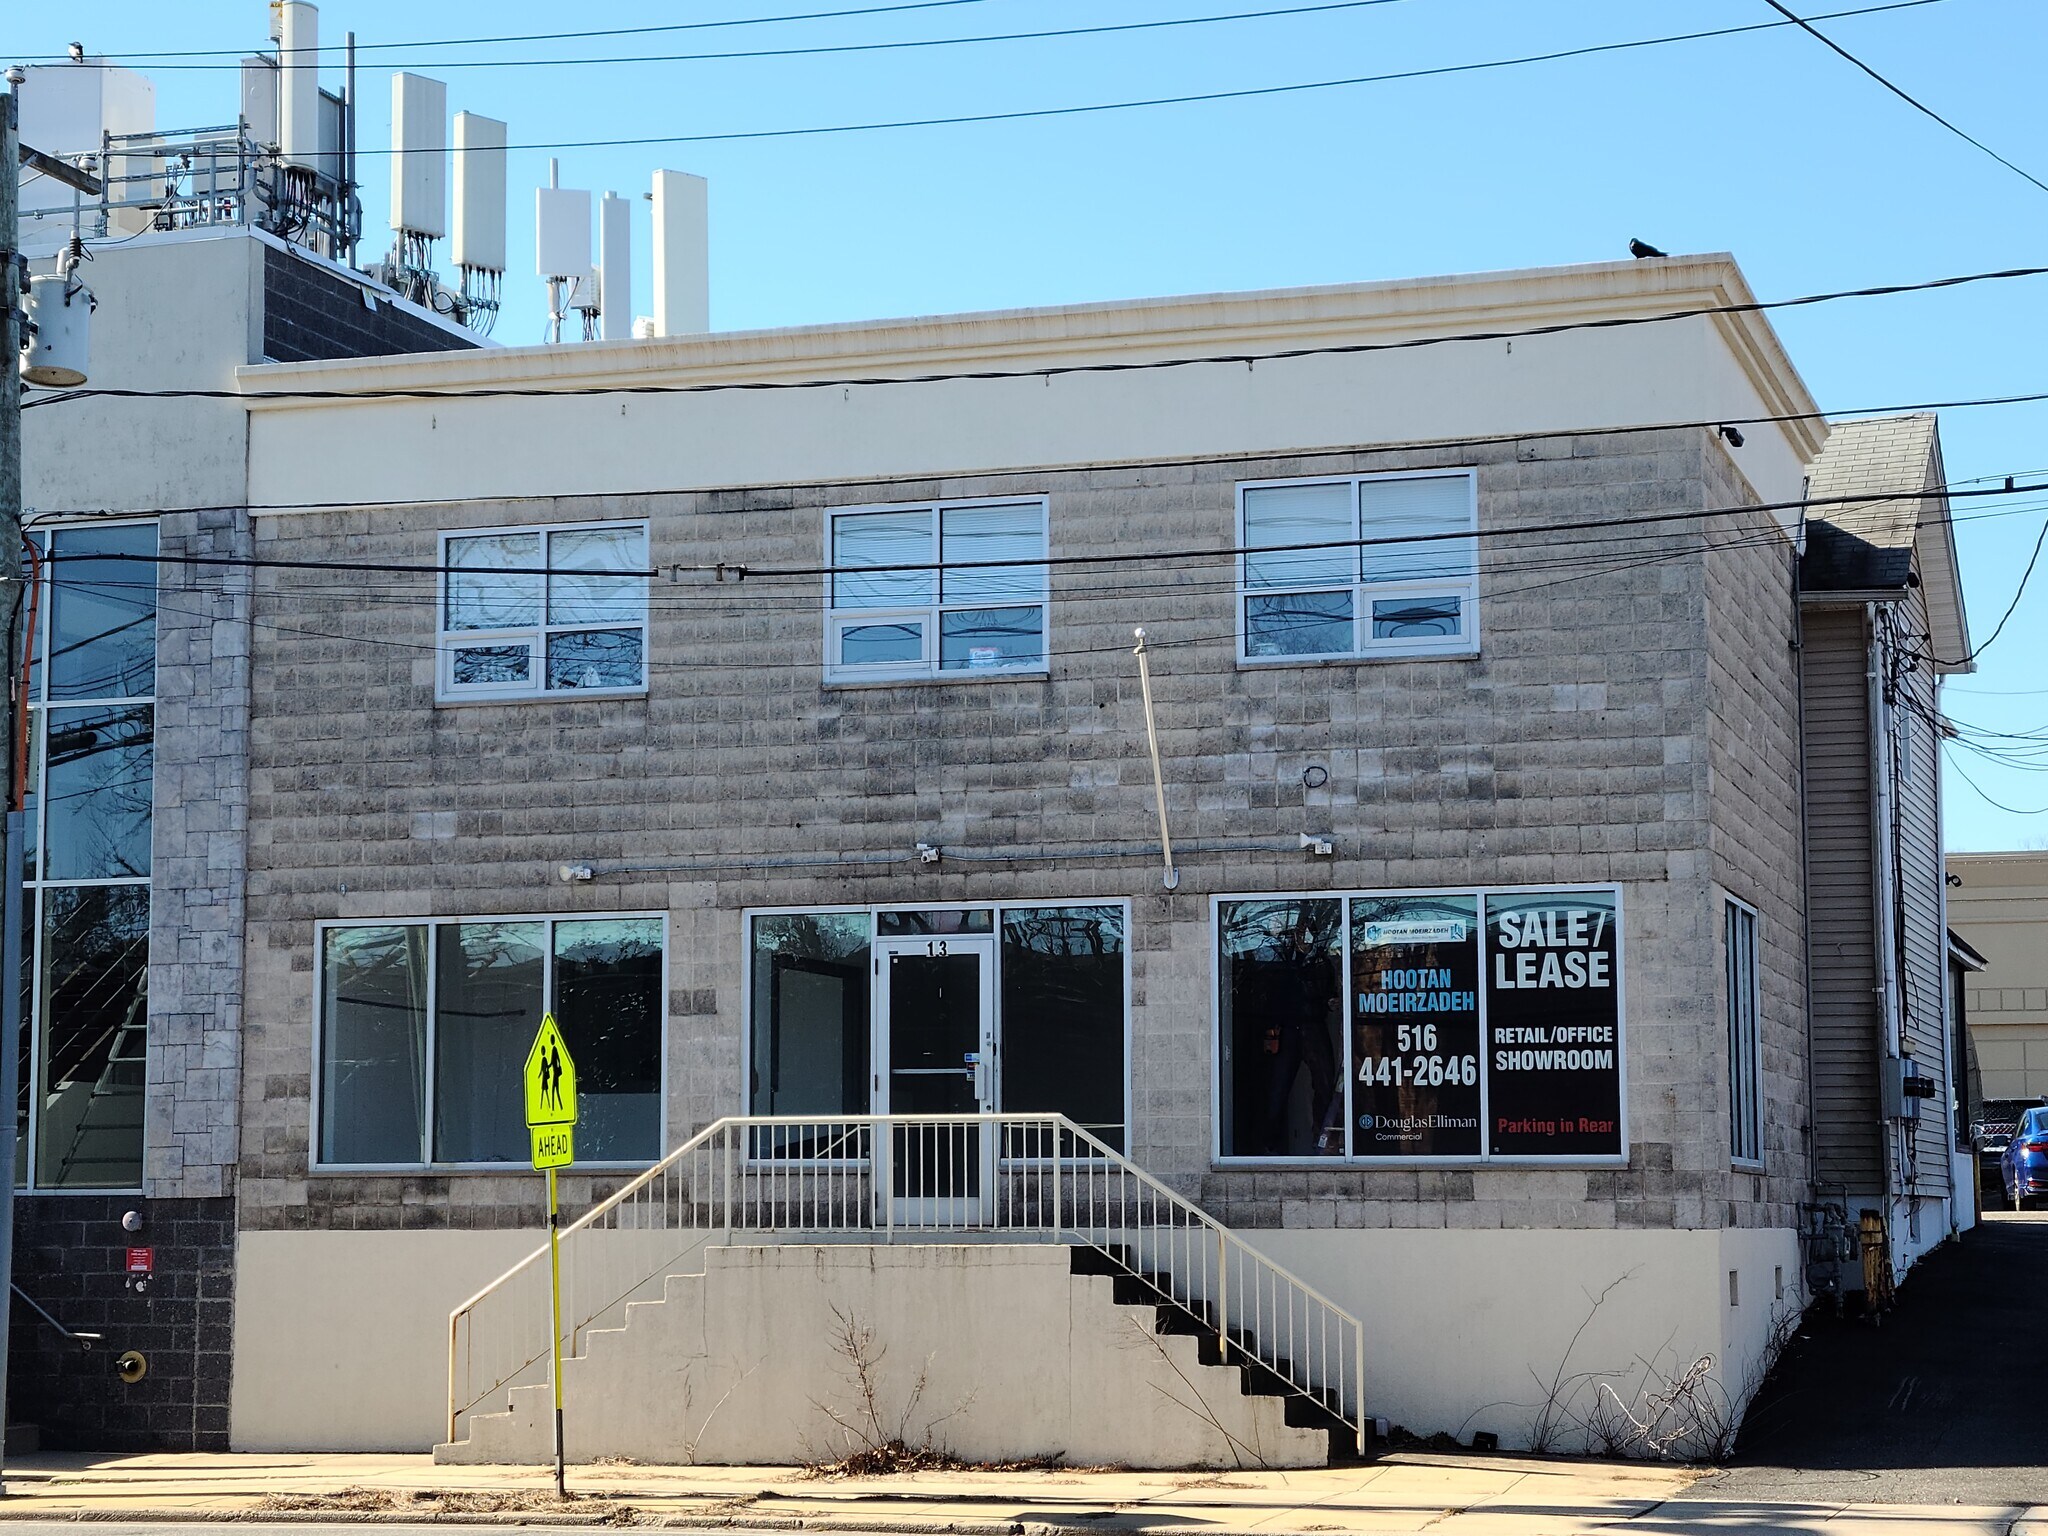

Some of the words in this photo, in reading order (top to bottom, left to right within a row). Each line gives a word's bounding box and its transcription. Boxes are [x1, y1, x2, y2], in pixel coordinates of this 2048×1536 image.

[927, 940, 948, 957] 13
[1381, 968, 1451, 990] HOOTAN
[1495, 951, 1610, 989] LEASE
[1359, 991, 1474, 1013] MOEIRZADEH
[1397, 1023, 1437, 1052] 516
[1495, 1026, 1613, 1044] RETAIL/OFFICE
[1358, 1054, 1477, 1087] 441-2646
[1495, 1049, 1613, 1071] SHOWROOM
[1375, 1132, 1423, 1141] Commercial
[1498, 1118, 1555, 1136] Parking
[1560, 1118, 1574, 1133] in
[1579, 1117, 1613, 1133] Rear
[538, 1134, 568, 1158] AHEAD
